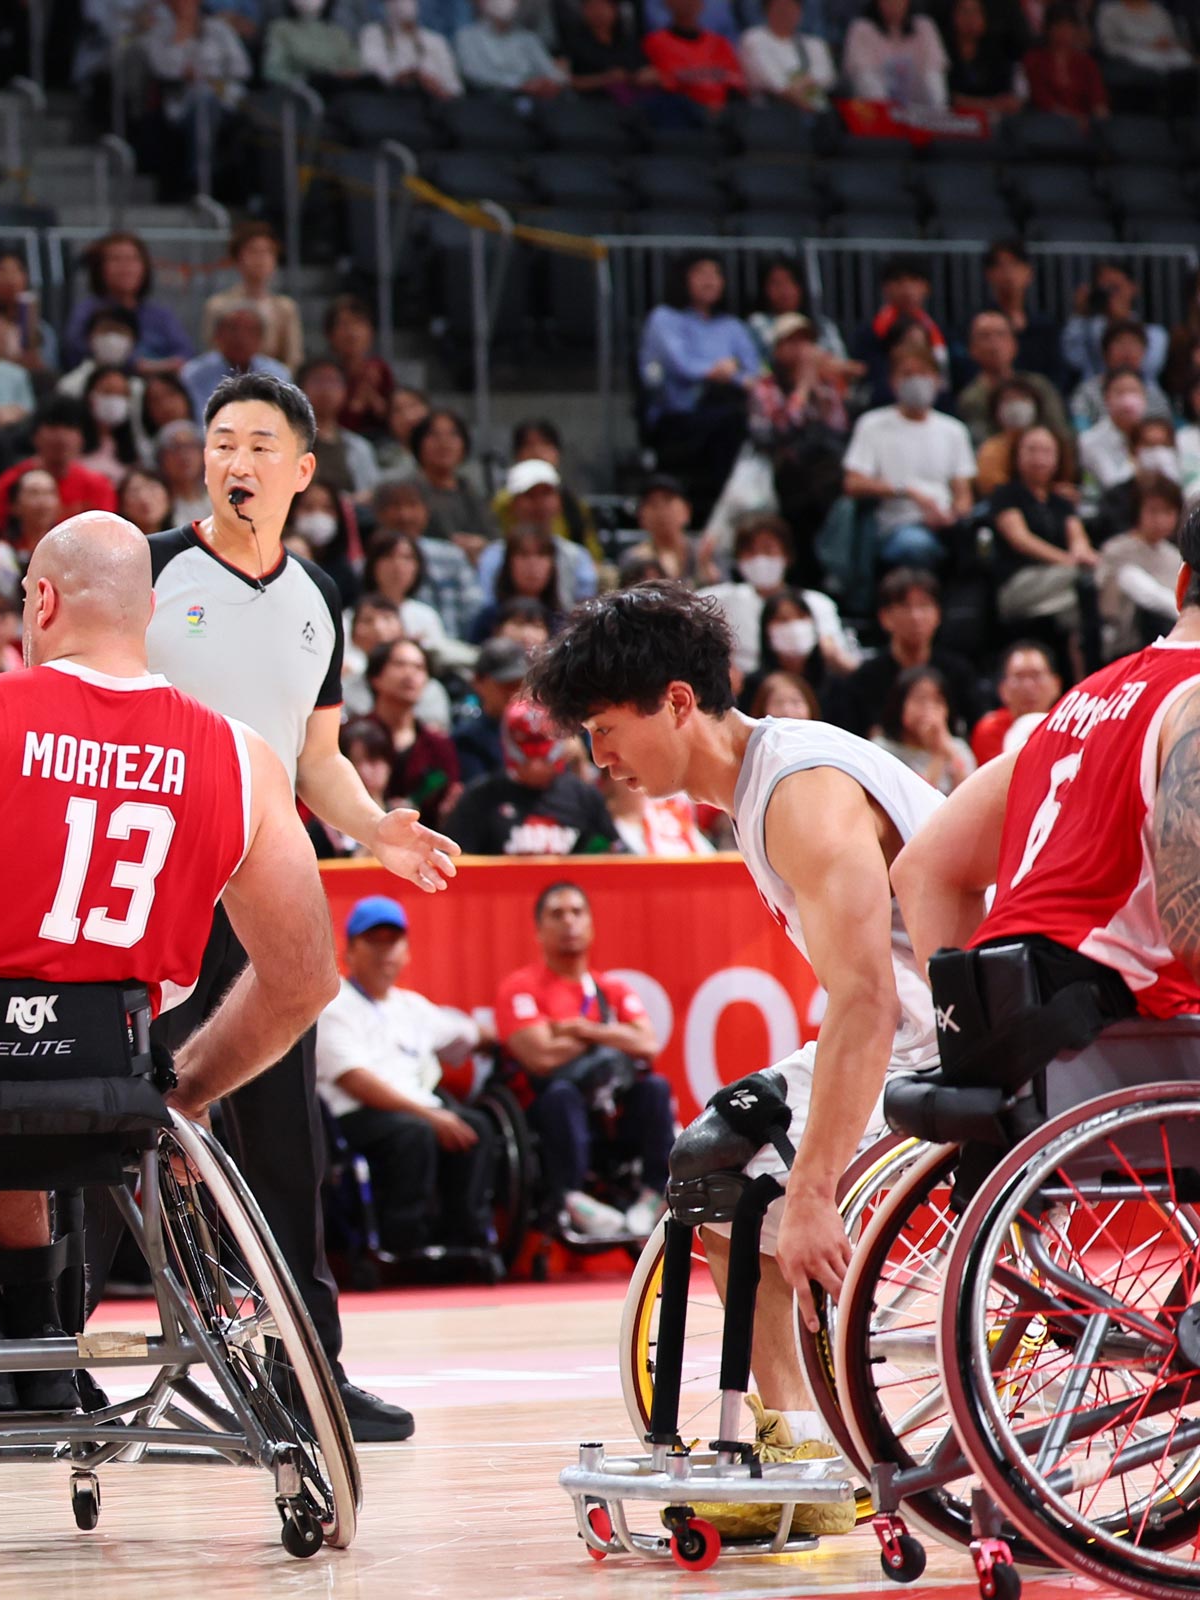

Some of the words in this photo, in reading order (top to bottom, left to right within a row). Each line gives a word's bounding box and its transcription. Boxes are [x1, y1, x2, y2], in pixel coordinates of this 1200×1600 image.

[21, 730, 186, 796] MORTEZA
[1009, 747, 1085, 890] 6
[37, 796, 177, 949] 13
